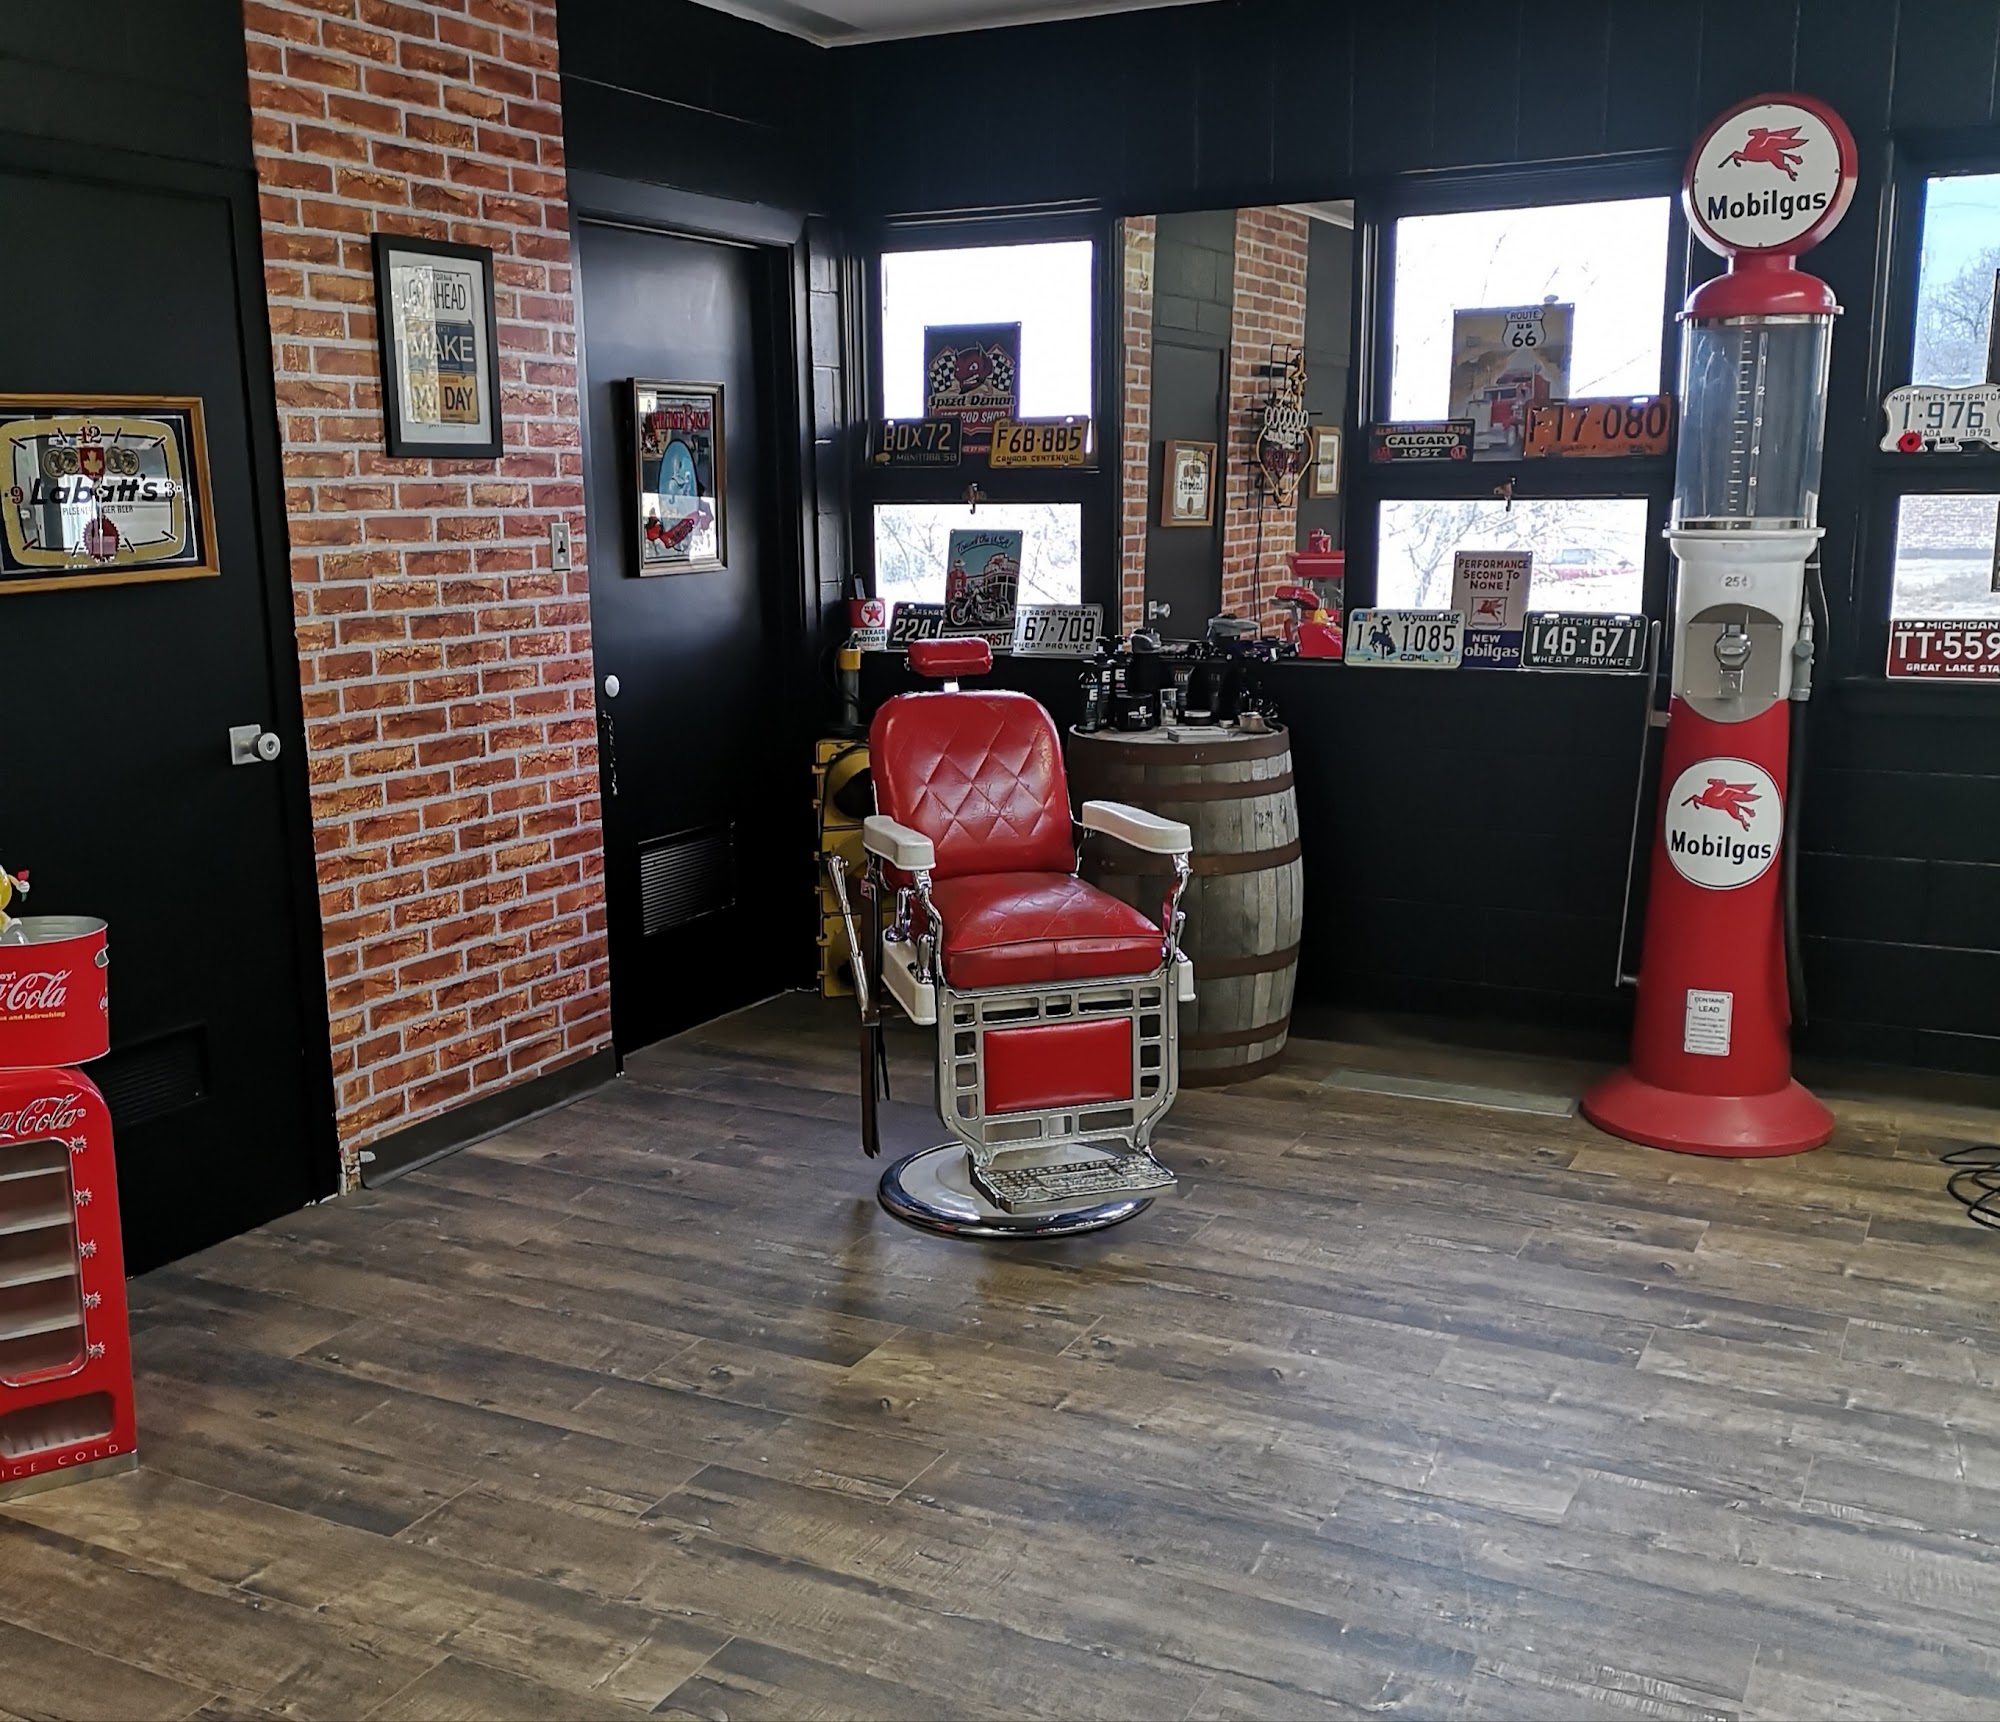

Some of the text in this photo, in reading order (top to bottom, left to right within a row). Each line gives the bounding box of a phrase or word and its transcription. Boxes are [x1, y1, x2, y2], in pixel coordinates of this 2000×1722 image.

[1707, 190, 1827, 221] Mobilgas
[431, 281, 466, 311] AHEAD
[1510, 310, 1540, 320] ROUTE
[1511, 331, 1538, 348] 66
[408, 333, 475, 362] MAKE
[1760, 356, 1767, 366] 1
[1757, 386, 1766, 396] 2
[444, 386, 473, 412] DAY
[931, 395, 1015, 408] Speed Demon
[1892, 393, 1951, 401] NORTHWEST
[1754, 417, 1763, 427] 3
[78, 426, 102, 445] 12
[1965, 429, 1991, 437] 1979
[1388, 436, 1455, 445] CALGARY
[1402, 448, 1442, 457] 1927
[1751, 446, 1760, 455] 4
[996, 454, 1079, 463] CANADA CENTENNIAL
[1749, 477, 1758, 487] 5
[30, 473, 159, 506] Labatt's
[164, 481, 176, 499] 3
[10, 486, 24, 504] 9
[1458, 559, 1528, 569] PERFORMANCE
[1029, 609, 1098, 617] SASKATCHEWAN
[1398, 612, 1460, 625] Wyoming
[1532, 617, 1624, 628] SASKATCHEWAN
[1898, 621, 1999, 630] 19 MICHIGAN
[1402, 624, 1457, 652] 1085
[1472, 634, 1501, 643] NEW
[1532, 655, 1632, 667] WHEAT PROVINCE
[1906, 663, 1942, 672] GREAT
[1945, 664, 1975, 673] LAKE
[1671, 829, 1772, 865] Mobilgas
[1698, 1005, 1720, 1014] LEAD
[8, 1013, 23, 1021] and
[24, 1011, 66, 1021] Refreshing
[1, 1444, 119, 1478] ICE COLD
